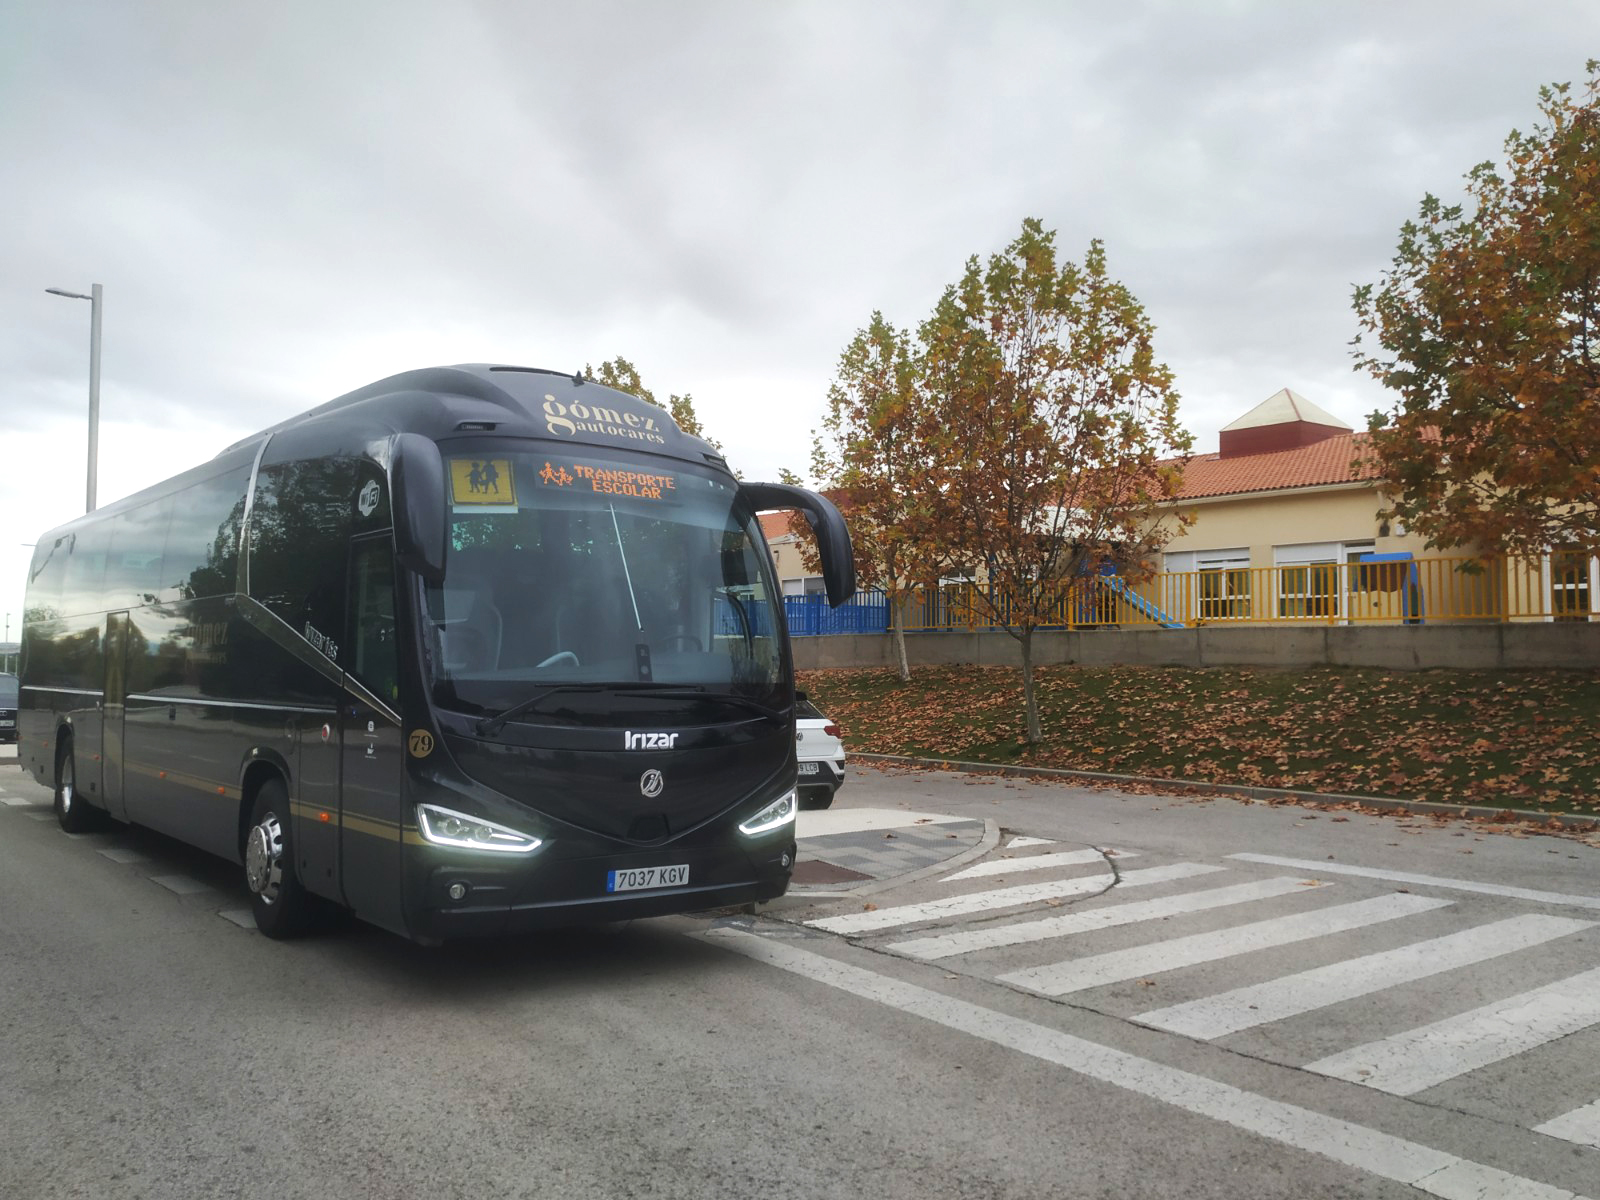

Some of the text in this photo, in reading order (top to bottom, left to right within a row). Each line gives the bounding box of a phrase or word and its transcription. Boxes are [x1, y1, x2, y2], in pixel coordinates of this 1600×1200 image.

[576, 421, 665, 444] autocares
[573, 464, 676, 489] TRANSPORTE
[592, 479, 662, 499] ESCOLAR
[410, 735, 432, 752] 79
[624, 730, 679, 749] Irizar
[618, 867, 686, 888] 7037 KGV
